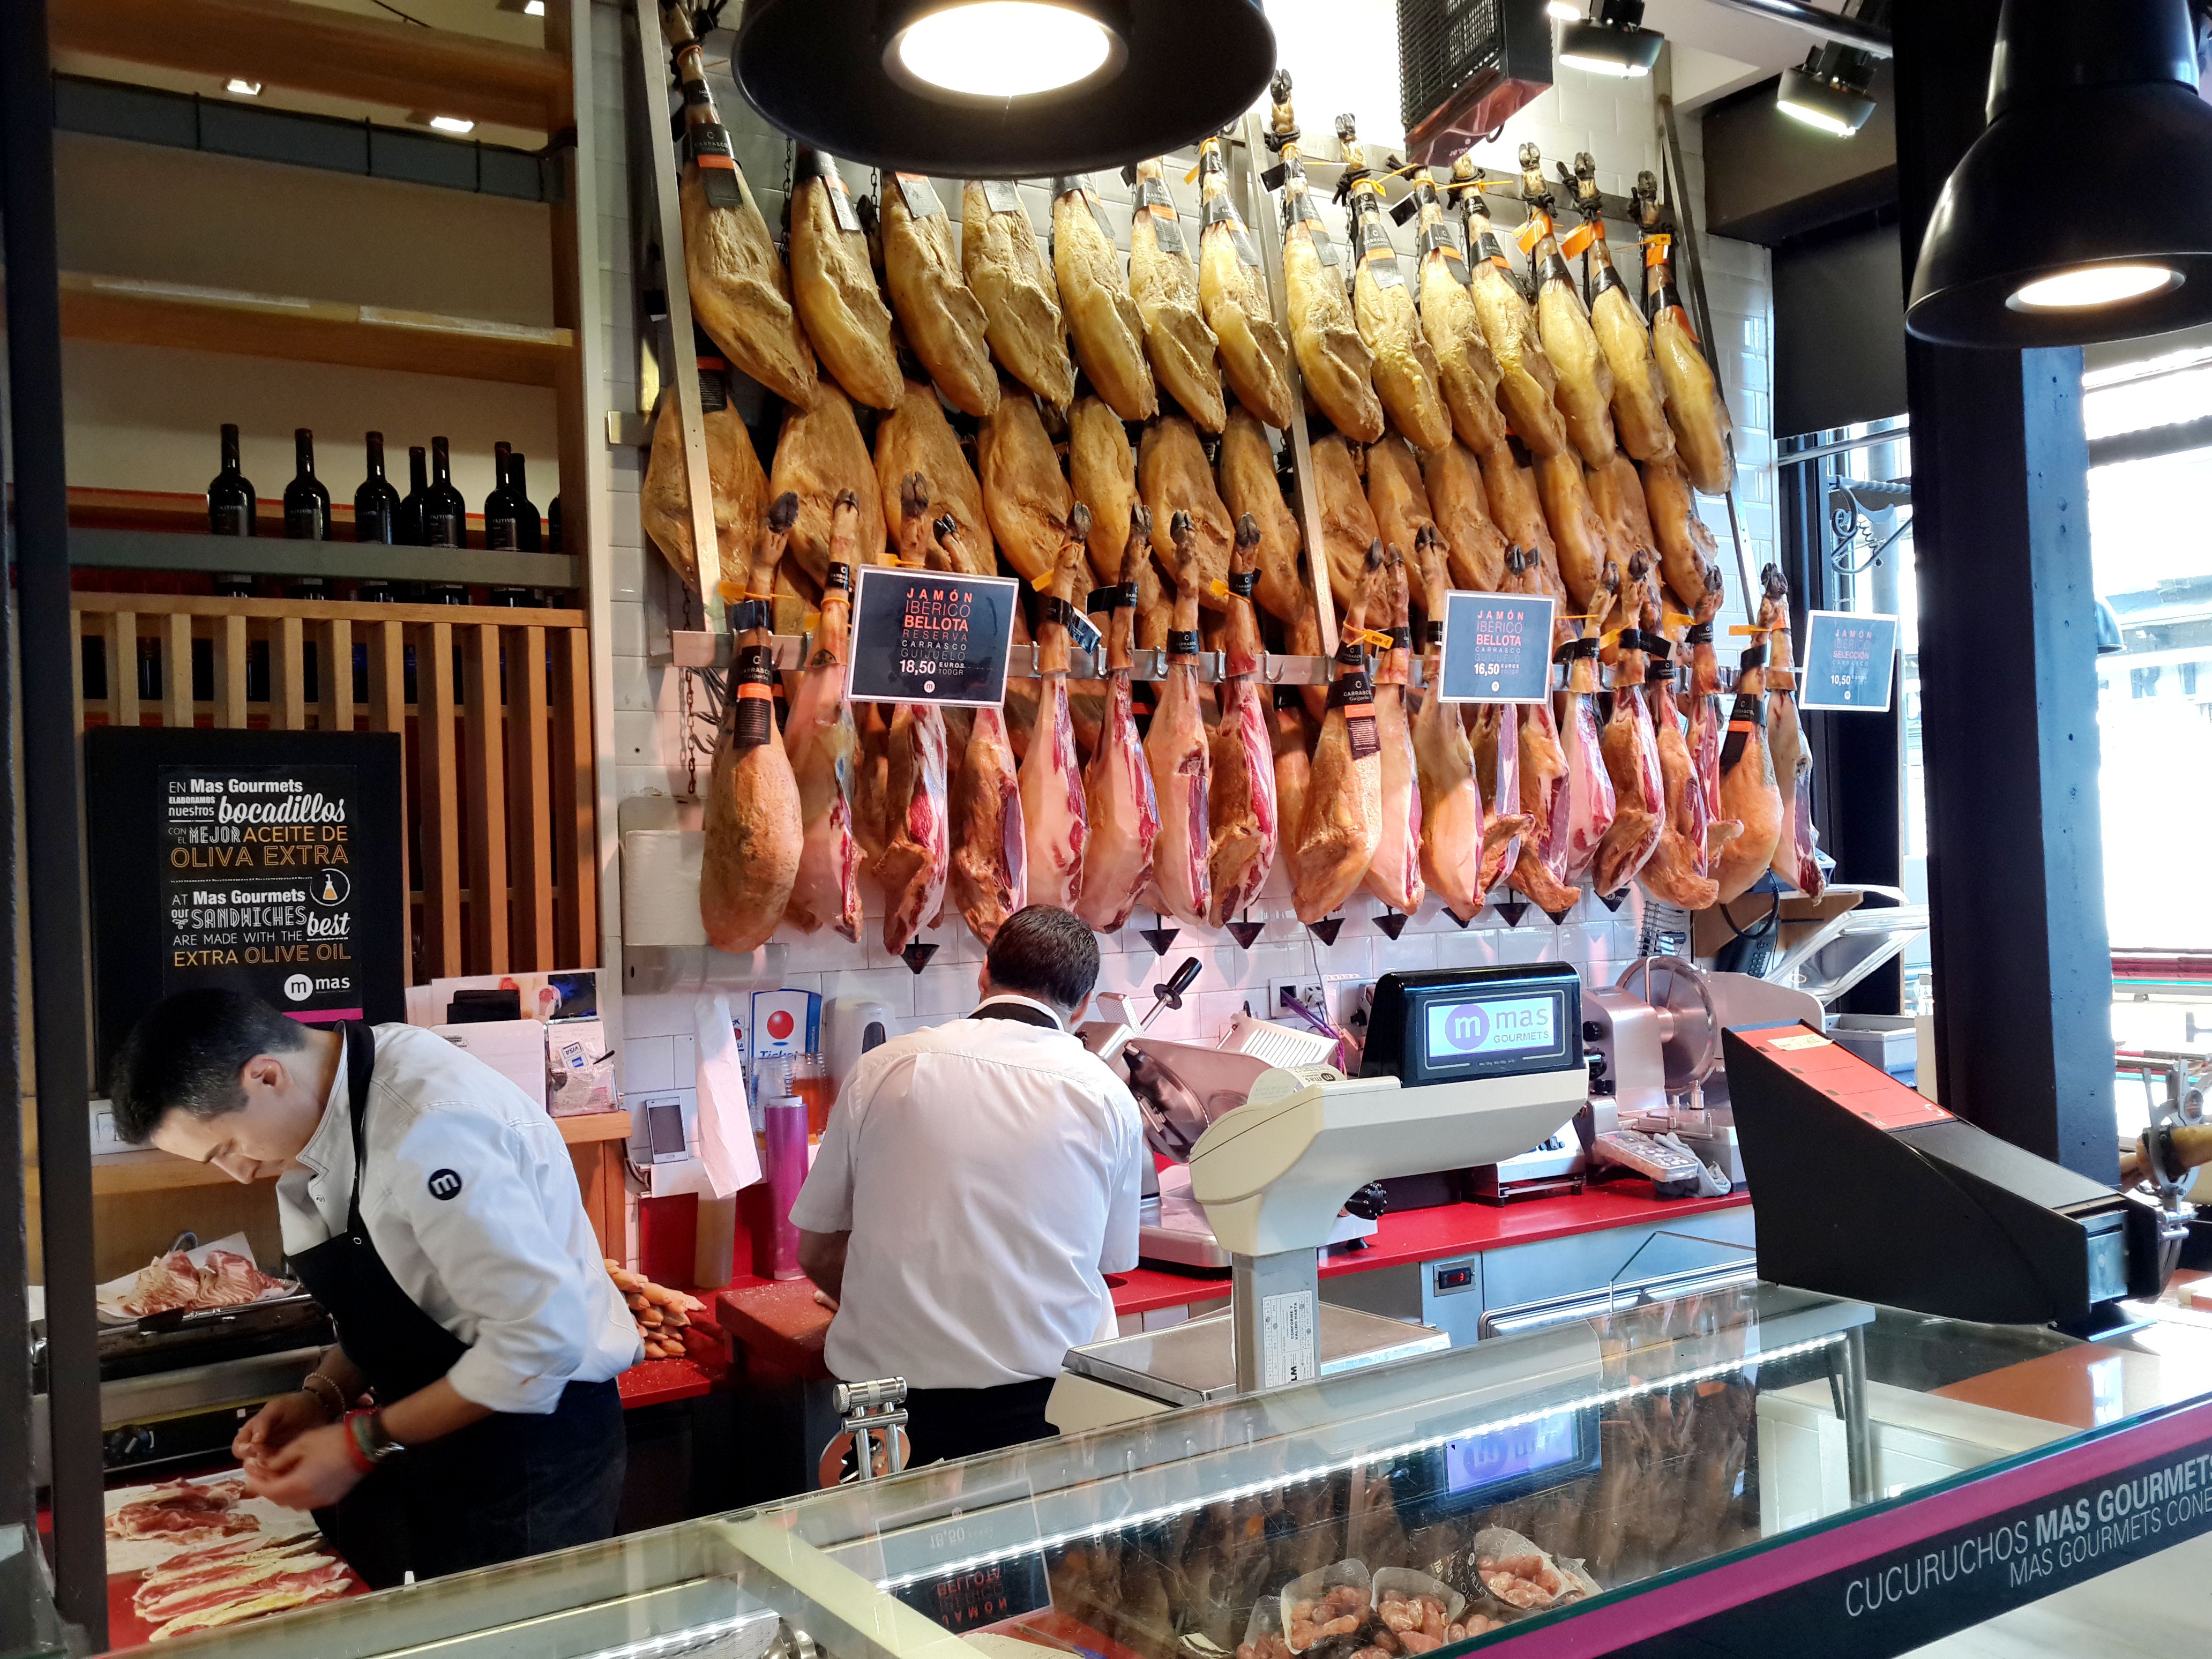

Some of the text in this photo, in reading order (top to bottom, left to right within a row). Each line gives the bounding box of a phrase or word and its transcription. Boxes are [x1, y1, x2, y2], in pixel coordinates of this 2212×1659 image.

[906, 587, 973, 603] JAMÓN
[906, 599, 971, 618] IBÉRICO
[1477, 610, 1524, 621] JAMÓN
[904, 615, 969, 632] BELLOTA
[1477, 620, 1523, 634] IBÉRICO
[902, 630, 967, 642] RESERVA
[1476, 634, 1521, 646] BELLOTA
[901, 640, 967, 651] CARRASCO
[900, 648, 966, 661] GUIJUELO
[899, 660, 936, 676] 18,50
[1474, 663, 1500, 676] 16,50
[1830, 674, 1851, 686] 10,50
[169, 778, 303, 793] EN Mas Gourmets
[169, 796, 215, 804] ELABORAMOS
[168, 805, 214, 817] nuestros
[218, 793, 346, 824] bocadillos
[168, 827, 186, 836] CON
[189, 825, 348, 844] MEJOR ACEITE DE
[170, 845, 349, 868] OLIVA EXTRA
[171, 888, 306, 906] AT Mas Gourmets
[171, 909, 189, 920] our
[191, 906, 307, 929] SANDWICHES
[307, 912, 351, 937] best
[173, 930, 303, 946] ARE MADE WITH THE
[174, 944, 352, 967] EXTRA OLIVE OIL
[315, 975, 351, 990] mas
[1496, 1007, 1549, 1030] mas
[1493, 1030, 1549, 1043] GOURMETS
[1845, 1453, 2212, 1617] CUCURUCHOS MAS GOURMET
[2010, 1548, 2053, 1588] MAS
[2059, 1506, 2162, 1568] GOURMETS
